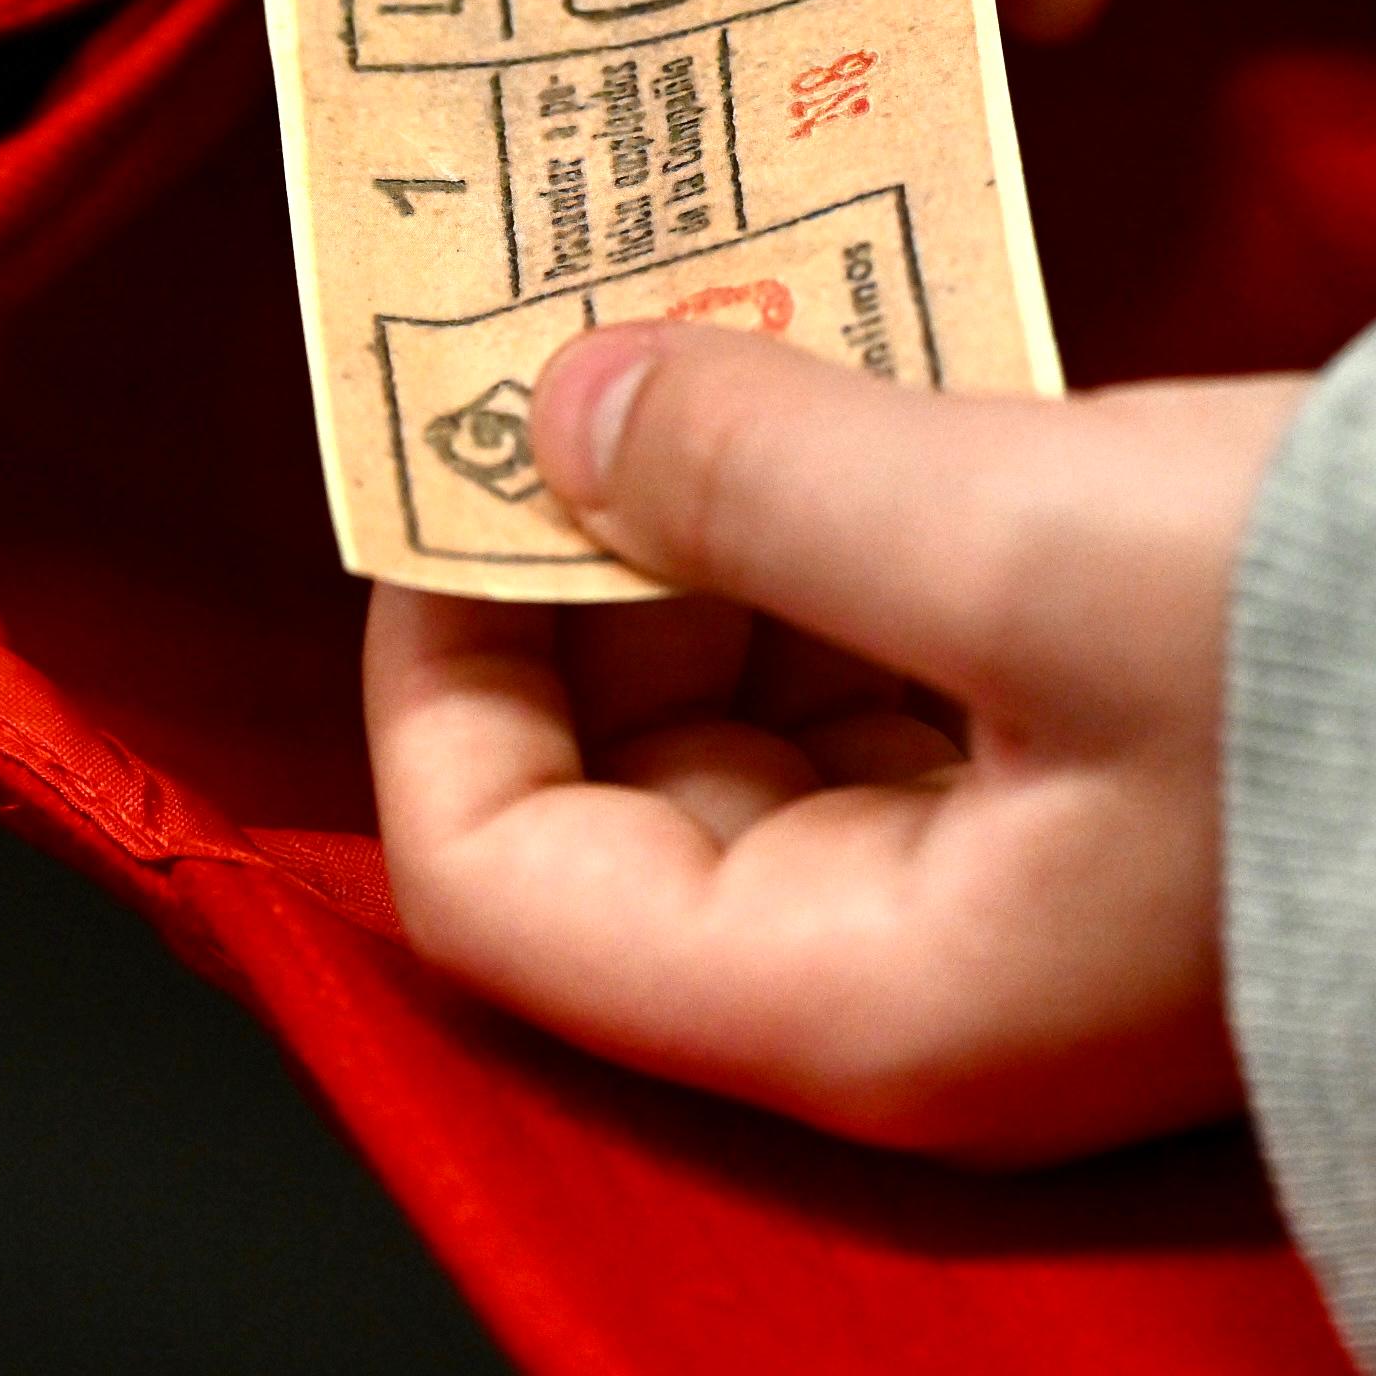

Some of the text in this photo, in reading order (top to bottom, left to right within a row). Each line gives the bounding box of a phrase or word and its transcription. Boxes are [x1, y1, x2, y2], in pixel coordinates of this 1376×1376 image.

[542, 124, 578, 141] a
[588, 60, 655, 189] empleados
[372, 177, 467, 217] 1
[664, 172, 707, 207] la
[667, 204, 711, 235] de
